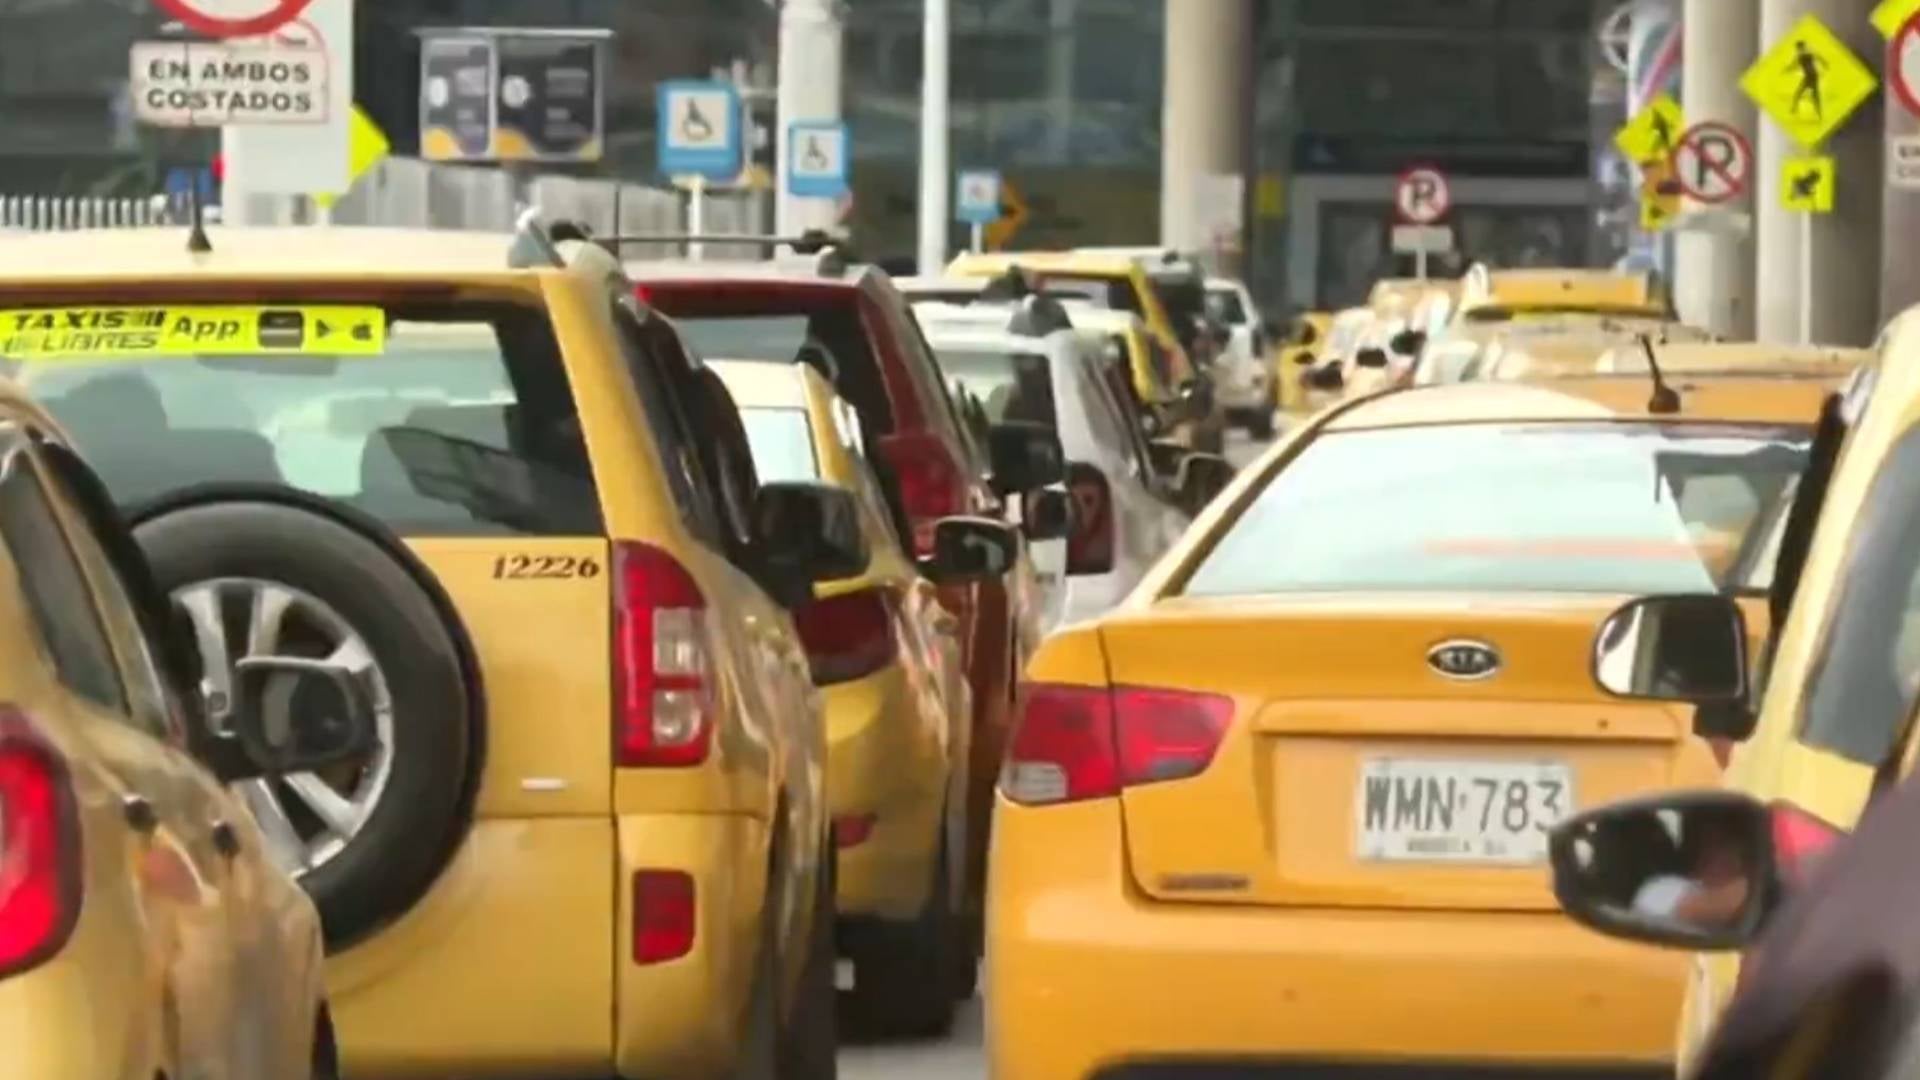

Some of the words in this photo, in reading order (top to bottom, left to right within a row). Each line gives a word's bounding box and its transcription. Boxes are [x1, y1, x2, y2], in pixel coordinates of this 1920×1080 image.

[150, 60, 190, 80] EN
[202, 61, 310, 83] AMBOS
[148, 88, 312, 112] COSTADOS
[15, 310, 128, 331] TAXIS
[170, 316, 241, 341] App
[493, 555, 600, 579] 12226
